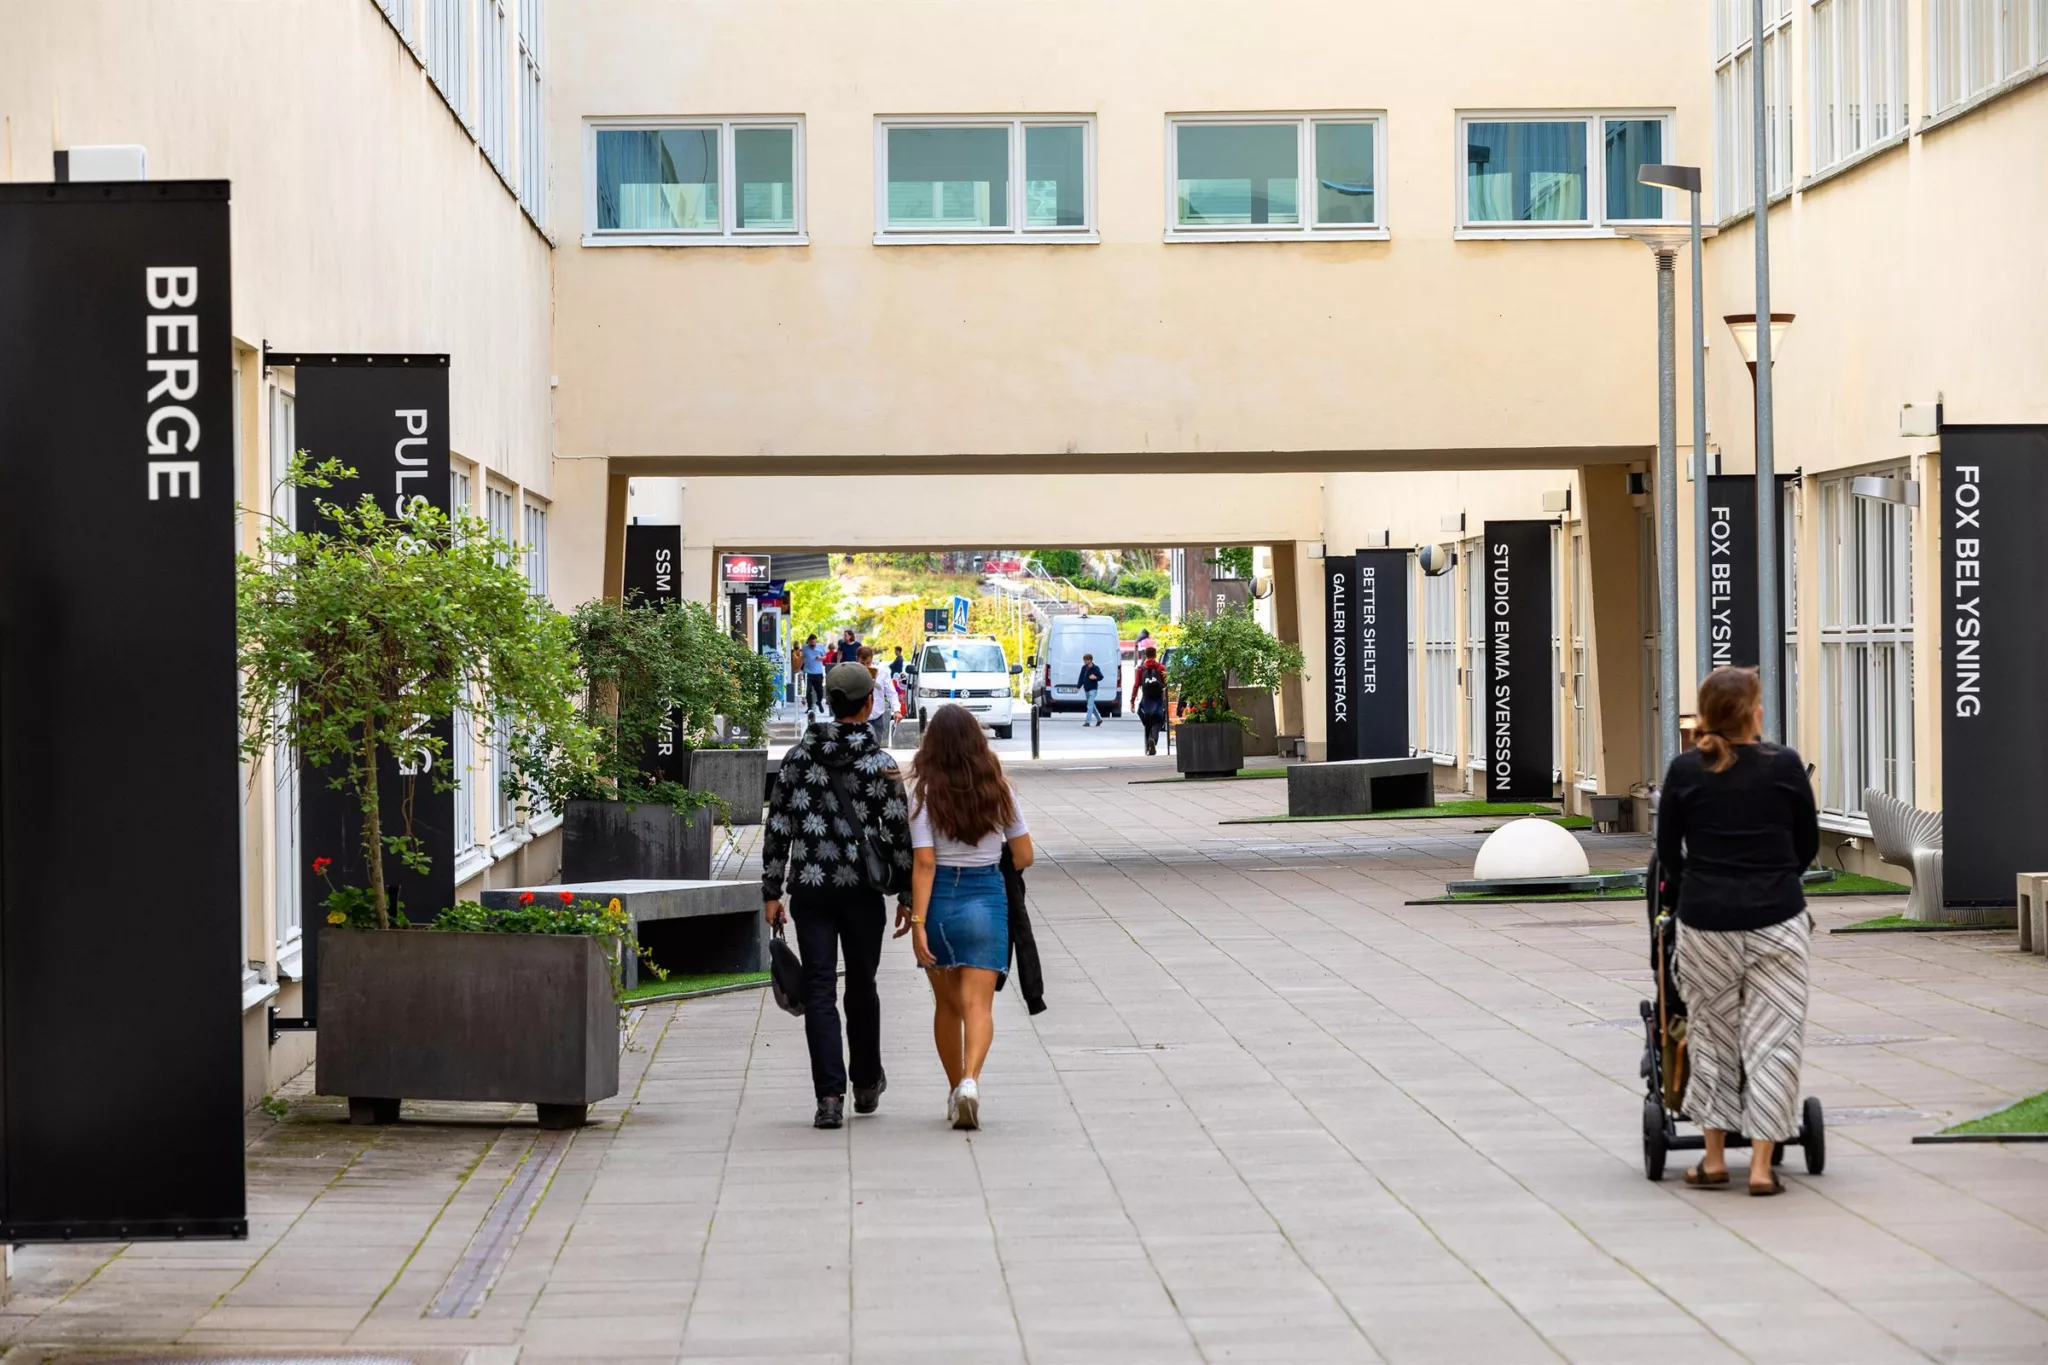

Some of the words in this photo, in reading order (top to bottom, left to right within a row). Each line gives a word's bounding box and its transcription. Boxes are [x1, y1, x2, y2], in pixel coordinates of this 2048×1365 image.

[146, 267, 200, 500] BERGE
[395, 409, 430, 522] PULS
[1955, 466, 1980, 529] FOX
[1711, 507, 1731, 556] FOX
[656, 549, 671, 591] SSM
[725, 562, 759, 574] Tonic
[1363, 568, 1375, 625] BETTER
[1494, 544, 1509, 615] STUDIO
[1333, 573, 1345, 633] GALLERI
[1712, 564, 1732, 669] BELYSNI
[1956, 539, 1981, 717] BELYSNING
[1334, 637, 1347, 722] KONSTFACK
[1363, 629, 1376, 693] SHELTER
[1495, 622, 1510, 680] EMMA
[658, 686, 673, 756] OWER
[1495, 686, 1511, 789] SVENSSON
